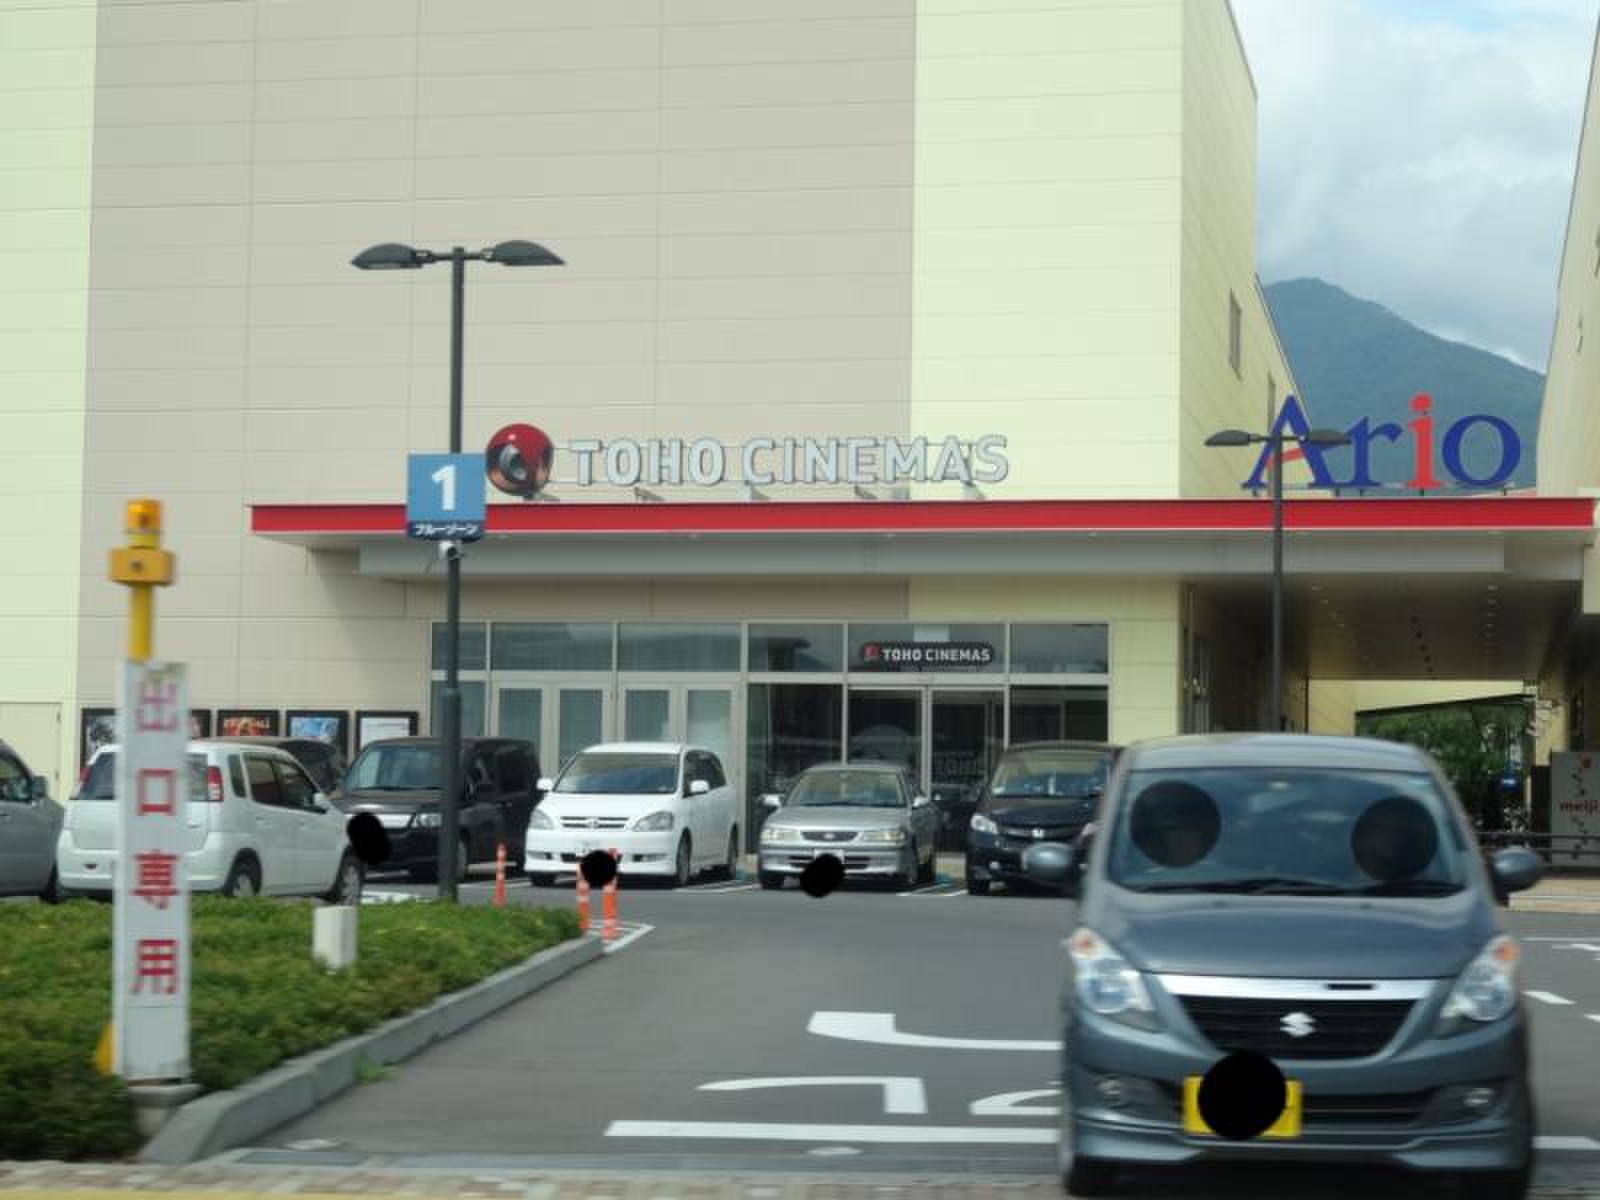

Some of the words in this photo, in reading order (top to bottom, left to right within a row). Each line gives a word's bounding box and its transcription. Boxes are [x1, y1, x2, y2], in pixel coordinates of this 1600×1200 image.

[569, 438, 726, 487] TOHO
[741, 434, 1009, 486] CINEMAS
[1241, 394, 1521, 491] Ario
[431, 464, 457, 512] 1
[881, 647, 922, 662] TOHO
[925, 647, 991, 662] CINEMAS
[131, 679, 180, 995] 出口専用
